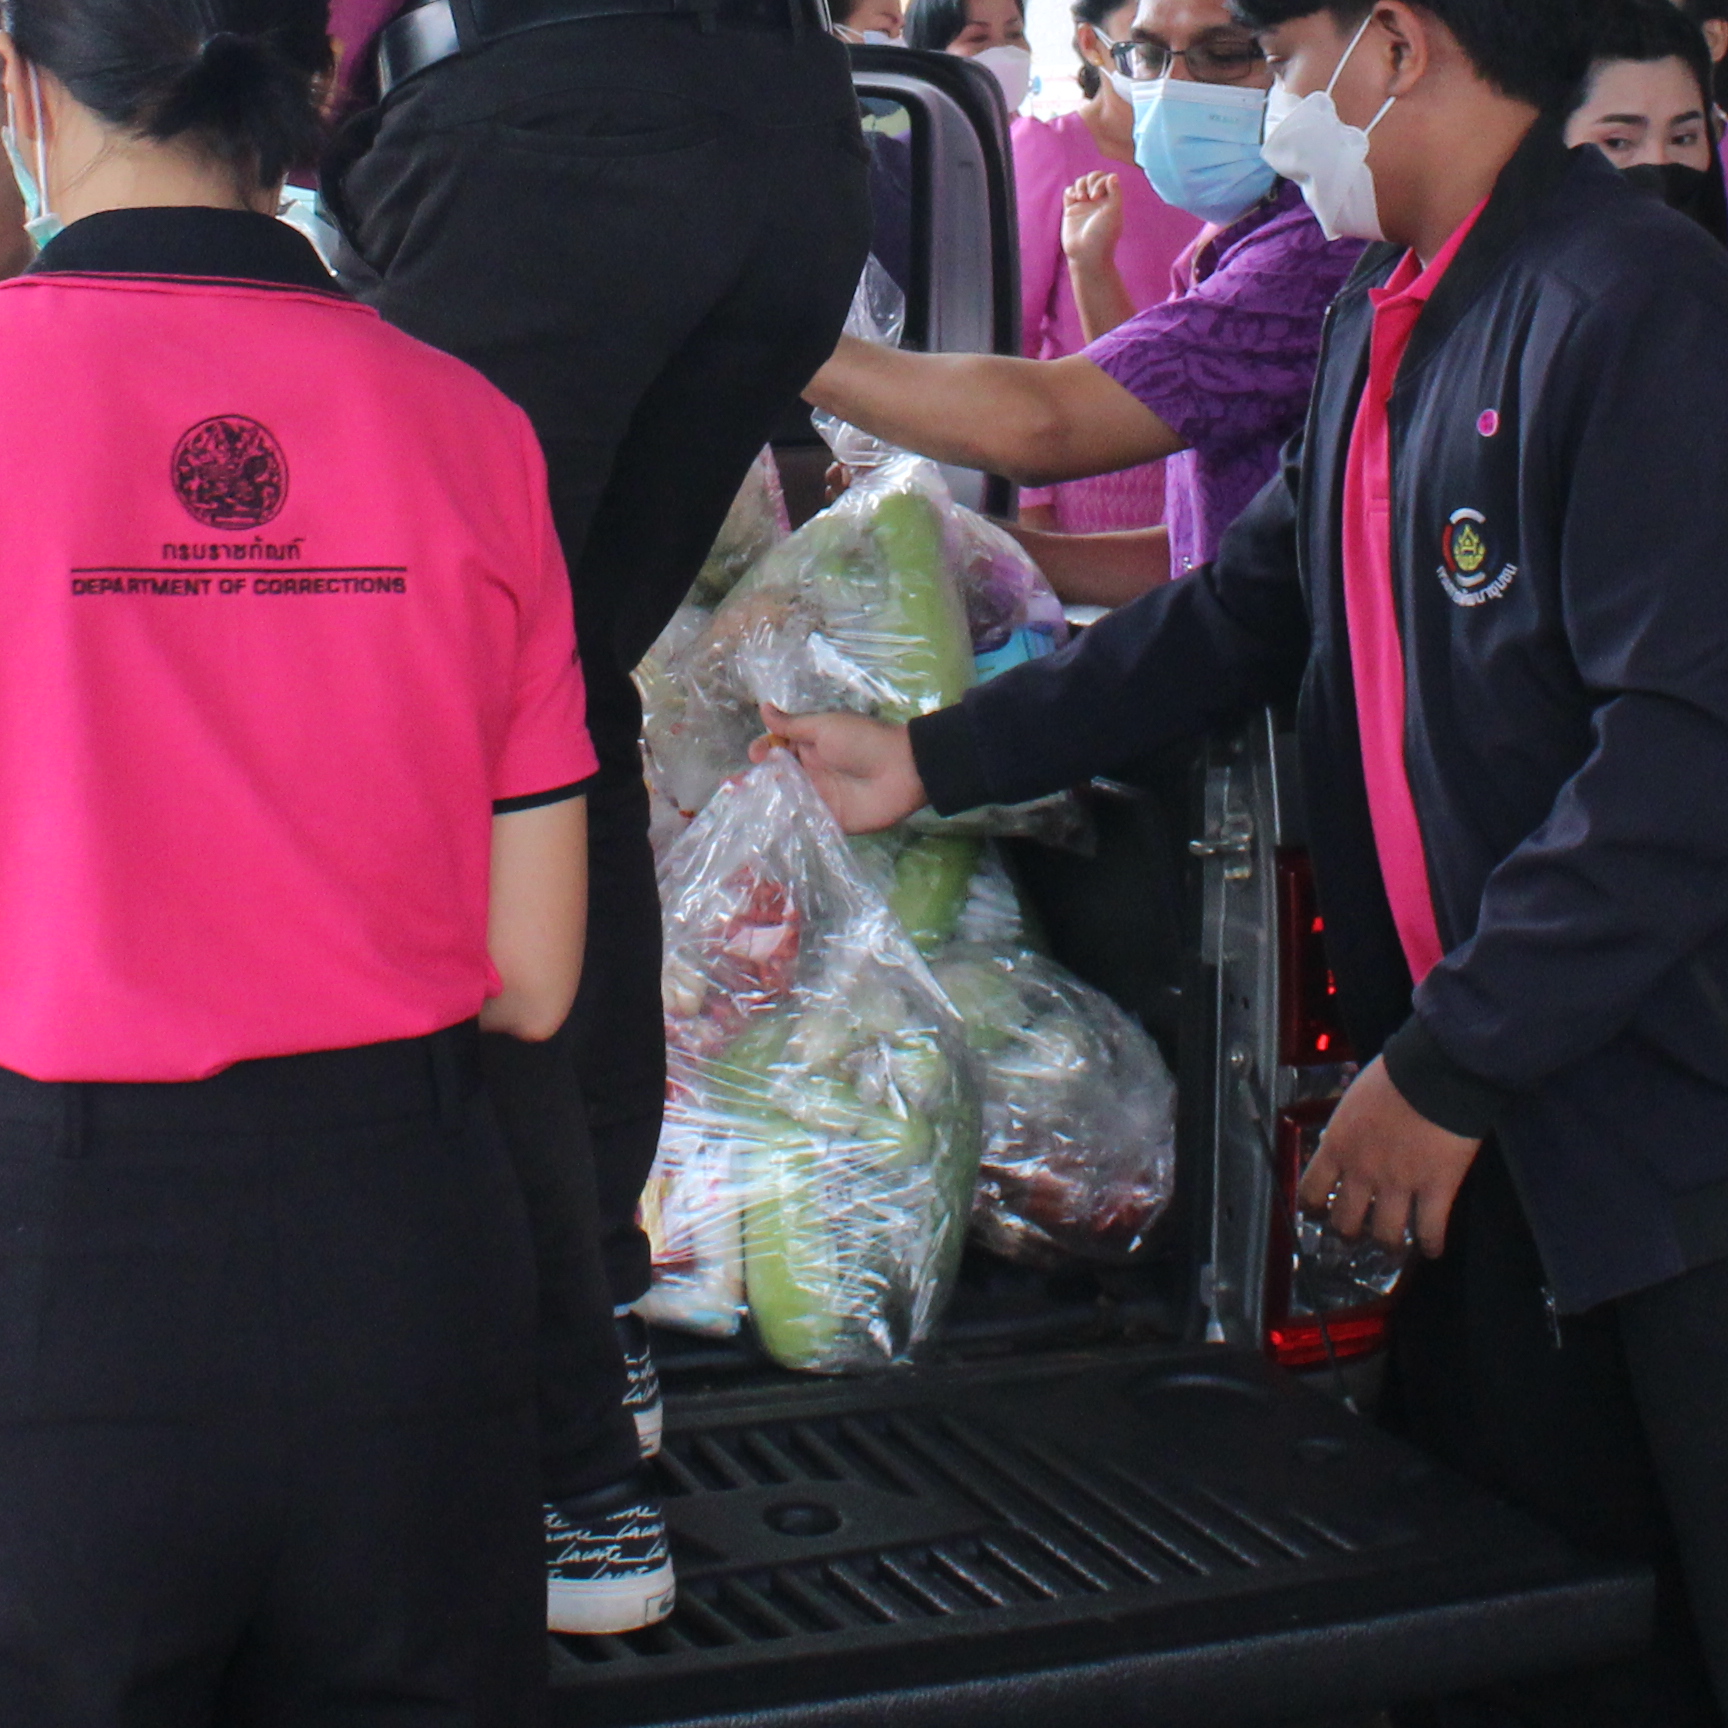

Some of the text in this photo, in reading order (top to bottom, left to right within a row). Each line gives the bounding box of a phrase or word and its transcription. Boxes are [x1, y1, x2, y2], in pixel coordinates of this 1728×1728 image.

[72, 576, 407, 596] DEPARTMENT OF CORRECTIONS
